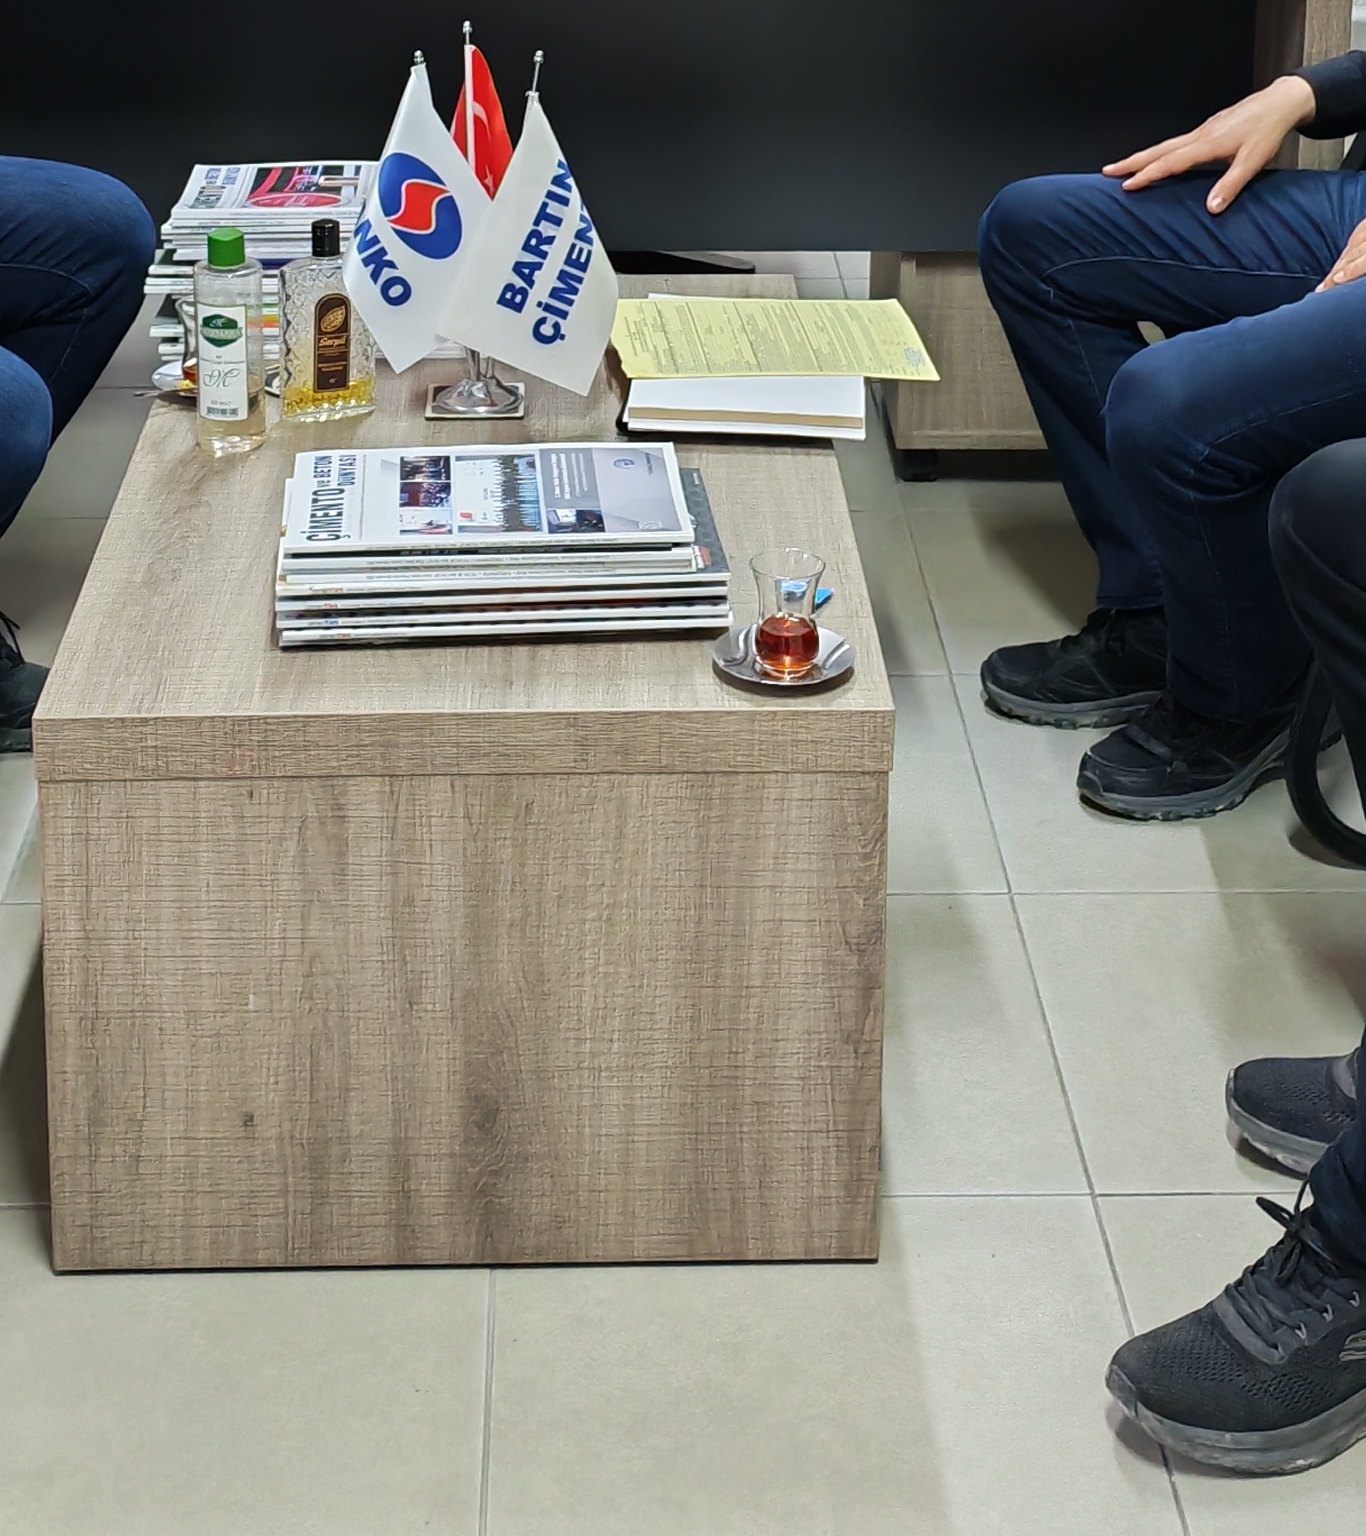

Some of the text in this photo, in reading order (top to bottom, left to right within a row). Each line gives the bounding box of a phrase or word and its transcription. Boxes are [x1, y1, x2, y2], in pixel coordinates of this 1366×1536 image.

[354, 197, 413, 307] NKO
[496, 158, 574, 315] BARTIN
[532, 202, 596, 346] ÇİMEN
[313, 455, 334, 479] BETON
[336, 454, 358, 487] DÜNYASI
[299, 487, 352, 542] ÇİMENTO
